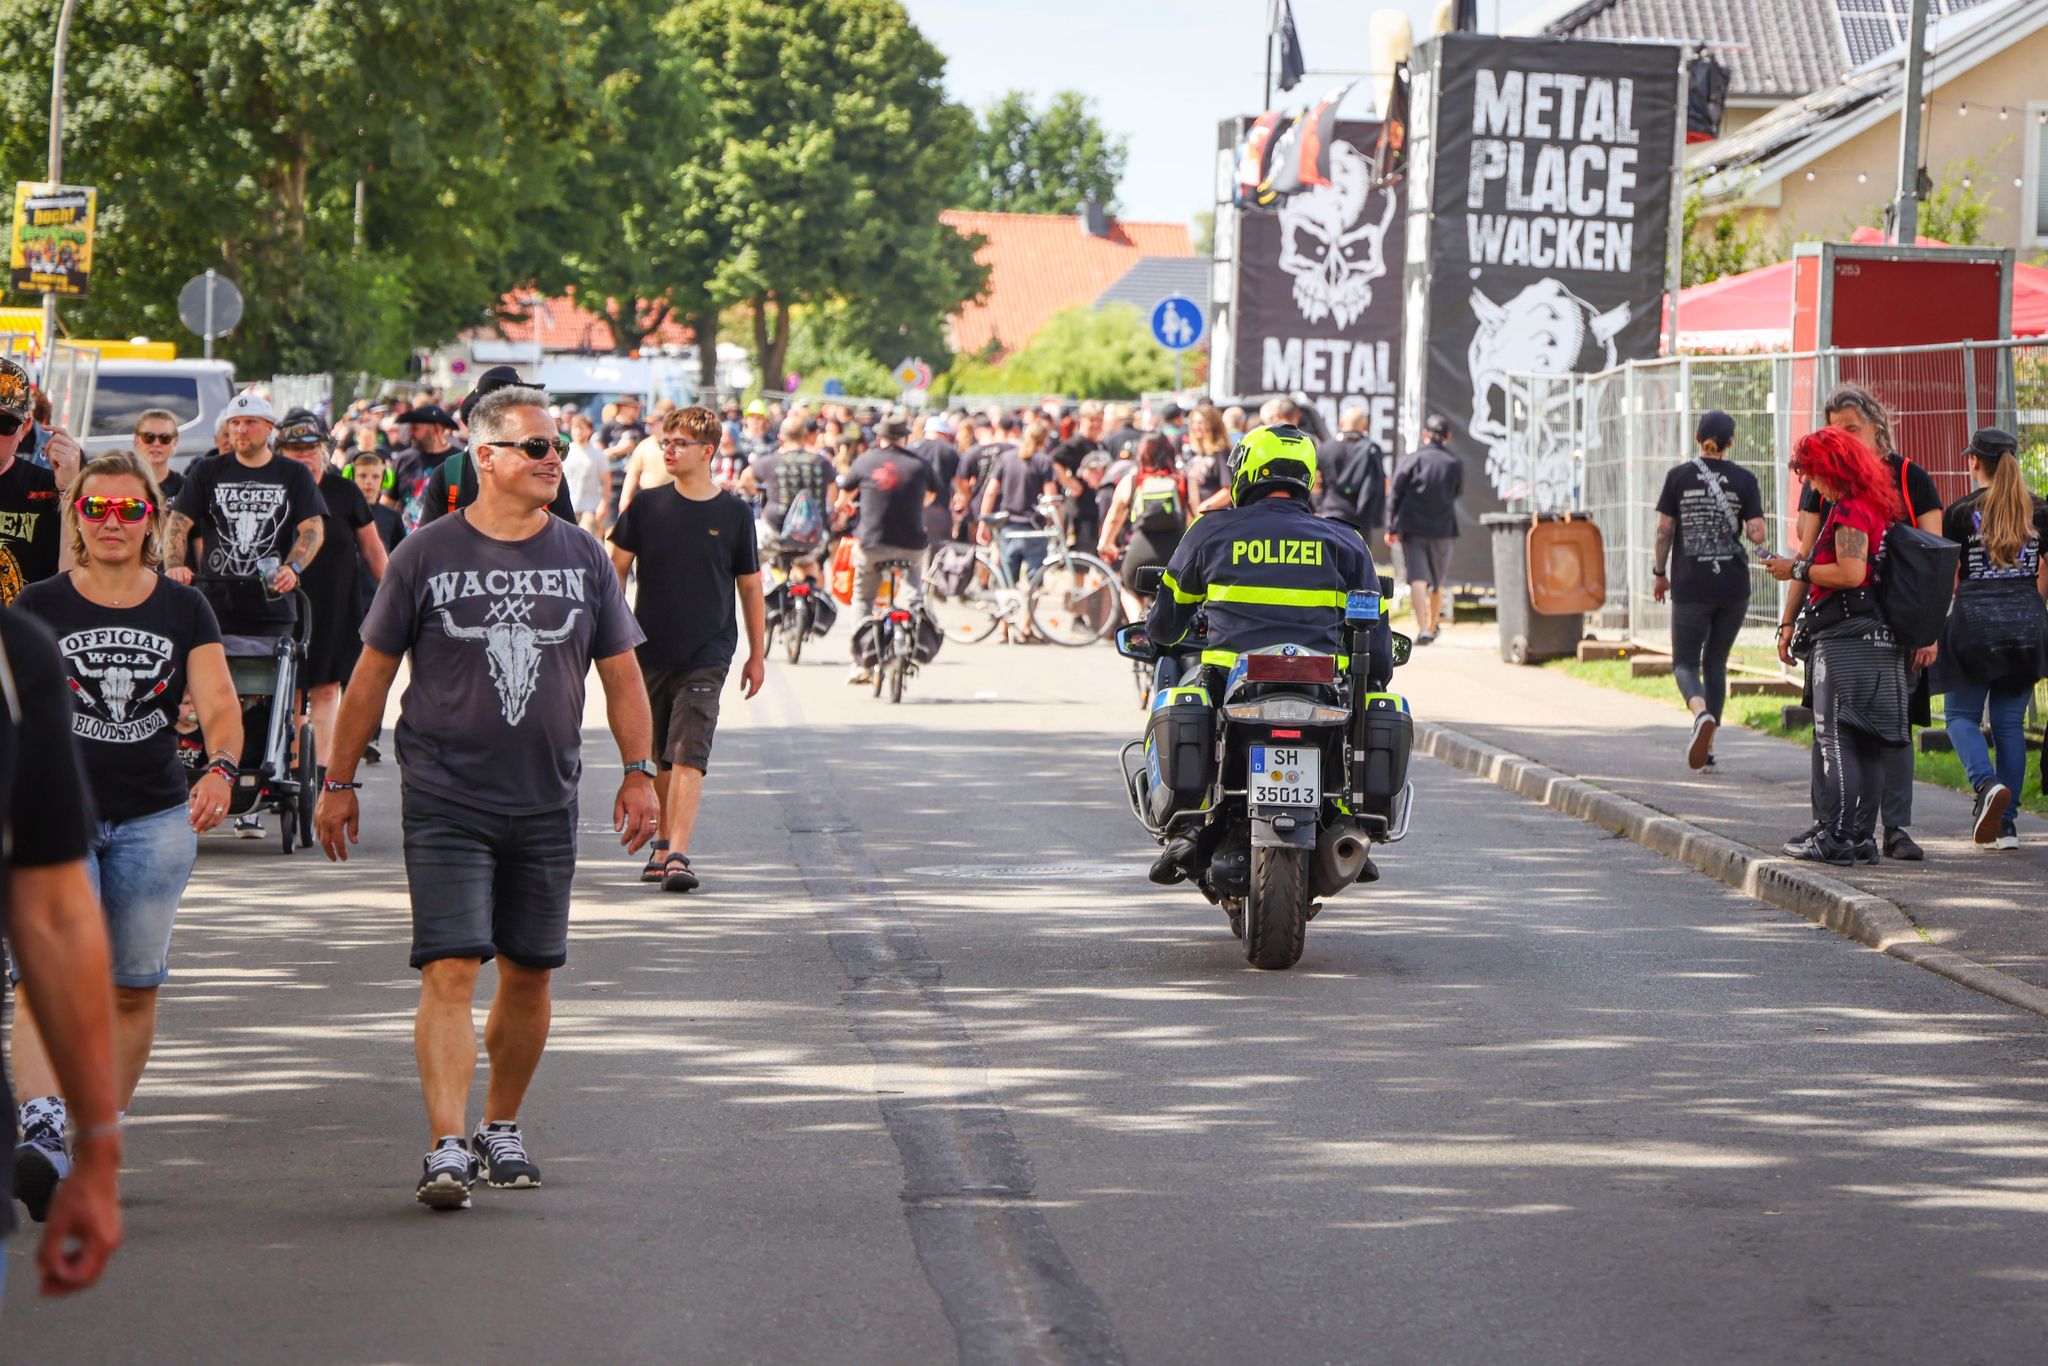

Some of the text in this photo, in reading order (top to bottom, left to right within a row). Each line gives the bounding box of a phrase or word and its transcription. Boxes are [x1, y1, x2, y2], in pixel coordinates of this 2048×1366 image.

[1472, 68, 1639, 144] METAL
[1467, 138, 1638, 218] PLACE
[1466, 213, 1634, 272] WACKEN
[1261, 337, 1396, 394] METAL
[214, 488, 287, 505] WACKEN
[229, 501, 268, 511] 2024
[1232, 539, 1322, 566] POLIZEI
[427, 568, 587, 607] WACKEN
[66, 630, 170, 655] OFFICIAL
[87, 652, 153, 664] W:O:A
[74, 712, 165, 741] BLOODSPONSOR
[1274, 749, 1298, 765] SH
[1256, 786, 1314, 803] 35013
